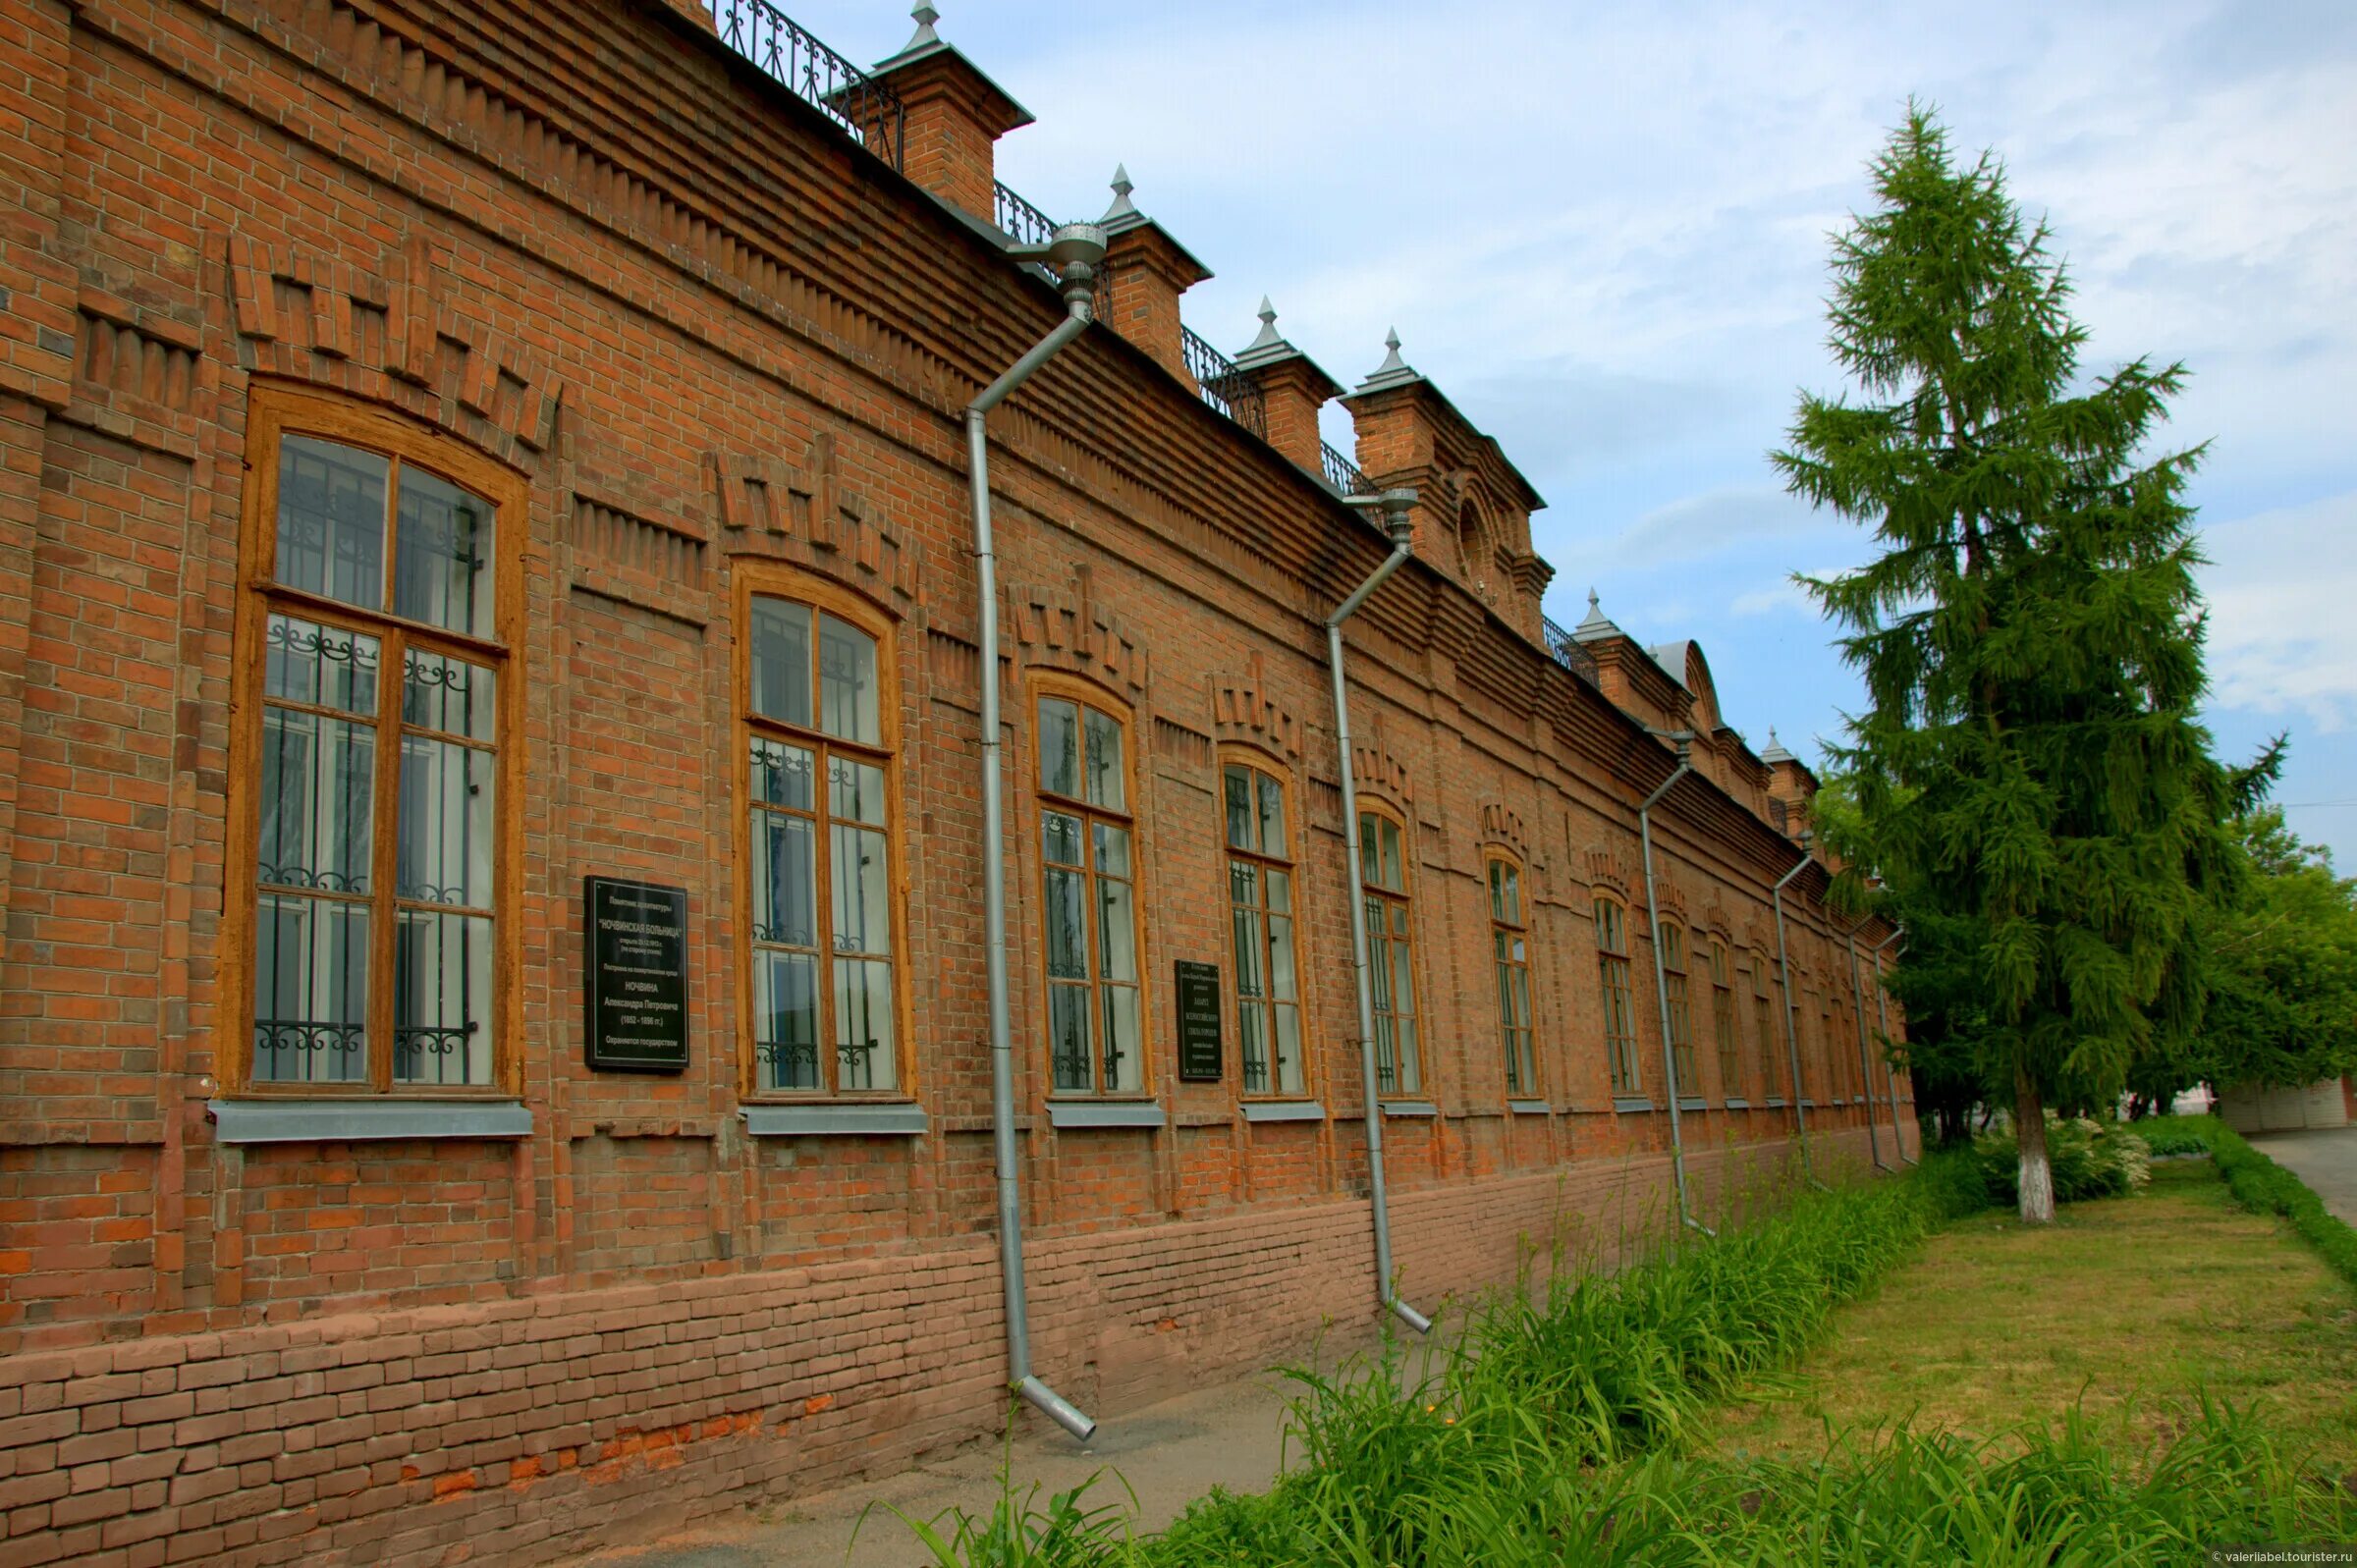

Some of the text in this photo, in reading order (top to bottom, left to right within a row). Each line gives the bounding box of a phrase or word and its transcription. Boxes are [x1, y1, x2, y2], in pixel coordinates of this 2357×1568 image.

[598, 919, 683, 938] "НОЧВИНСКАЯ БОЛЬНИЦА"
[625, 981, 659, 993] НОЧВИНА
